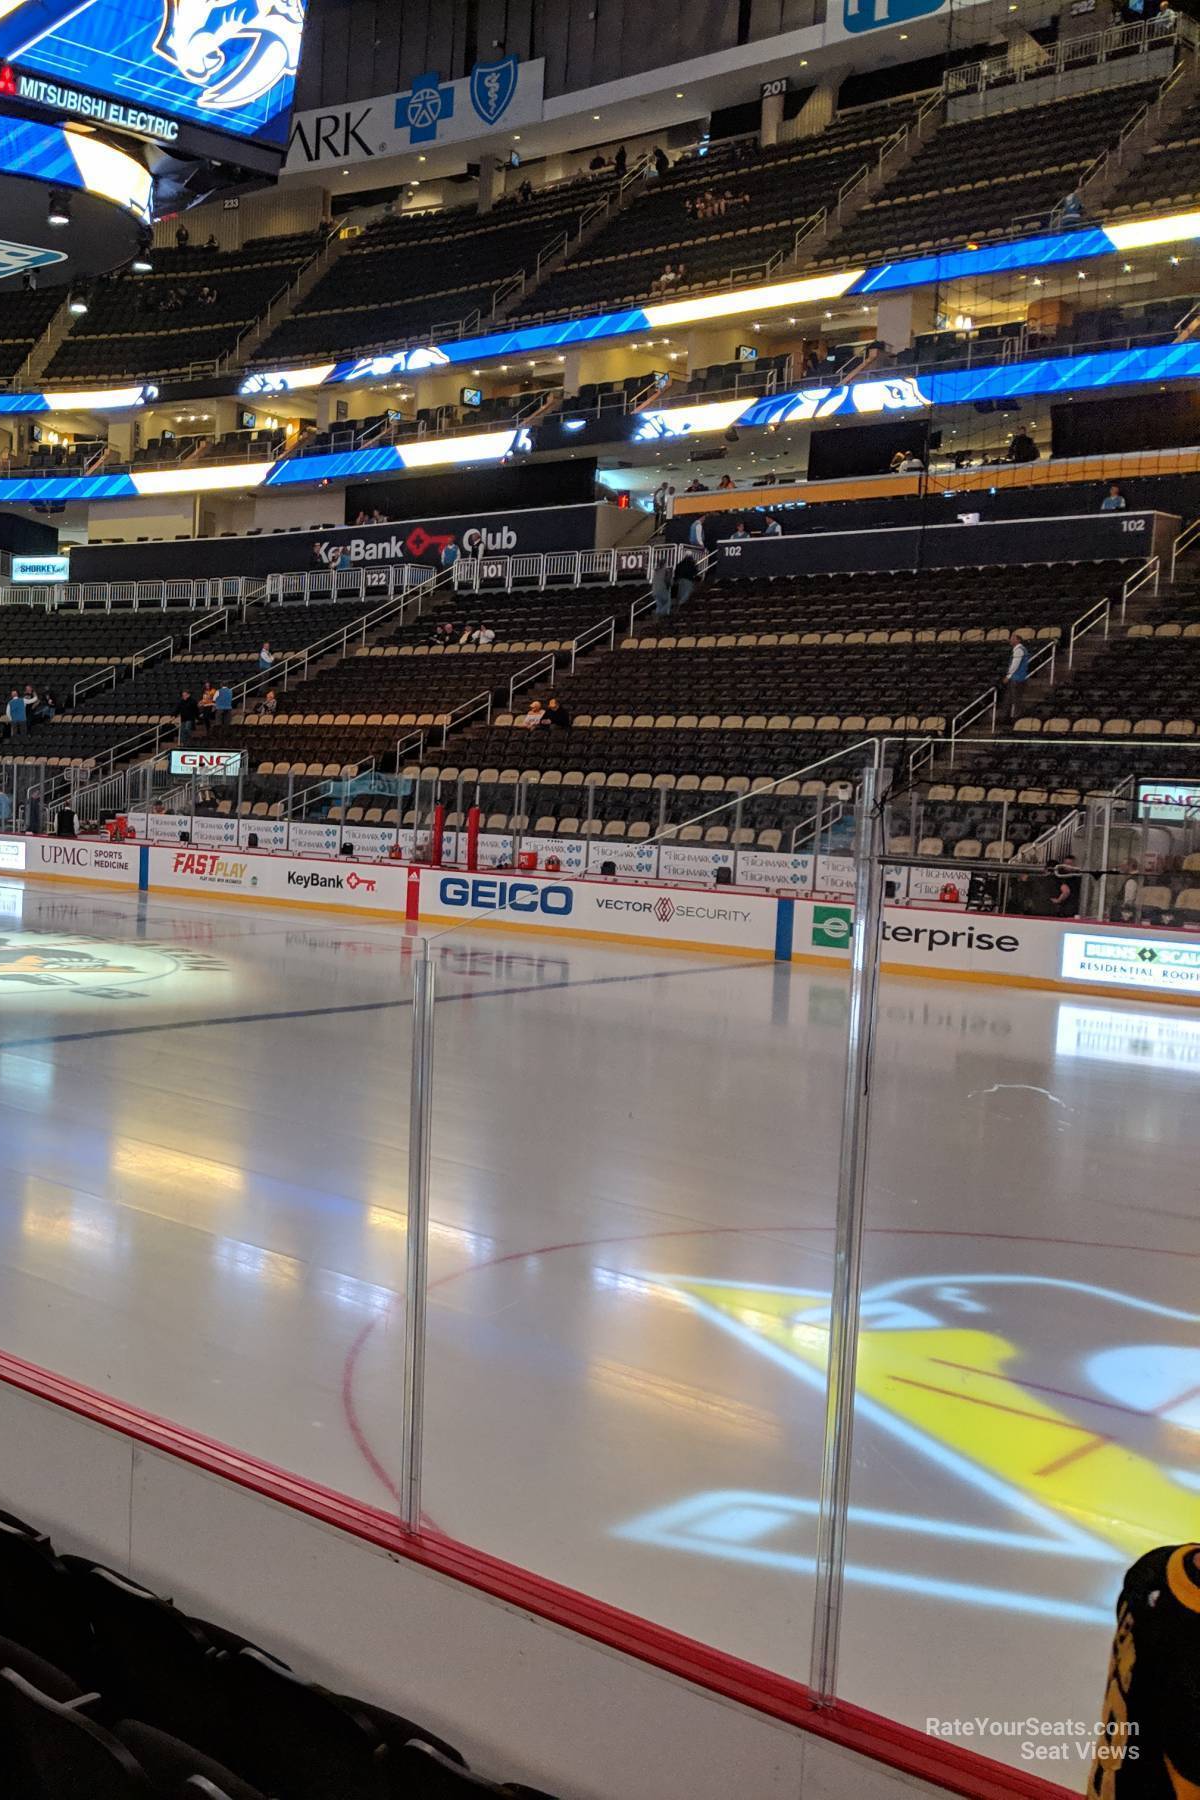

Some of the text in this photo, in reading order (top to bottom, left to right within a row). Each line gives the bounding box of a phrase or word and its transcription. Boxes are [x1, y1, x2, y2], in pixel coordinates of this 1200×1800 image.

[763, 80, 787, 97] 201
[19, 76, 179, 140] MITSUBISHI ELECTRIC
[1120, 519, 1146, 532] 102
[462, 525, 517, 551] Club
[724, 546, 742, 557] 102
[20, 564, 57, 573] SHORKEY
[620, 554, 643, 570] 101
[482, 564, 502, 578] 101
[366, 572, 387, 586] 122
[180, 754, 232, 766] GNC
[41, 845, 88, 866] UPMC
[94, 849, 123, 860] SPORTS
[94, 859, 129, 870] MEDICINE
[171, 853, 247, 878] FAST PLAY
[287, 871, 343, 889] KeyBank
[440, 877, 573, 915] GEICO
[596, 898, 751, 922] VECTOR SECURITY
[1080, 962, 1153, 977] RESIDENTIAL
